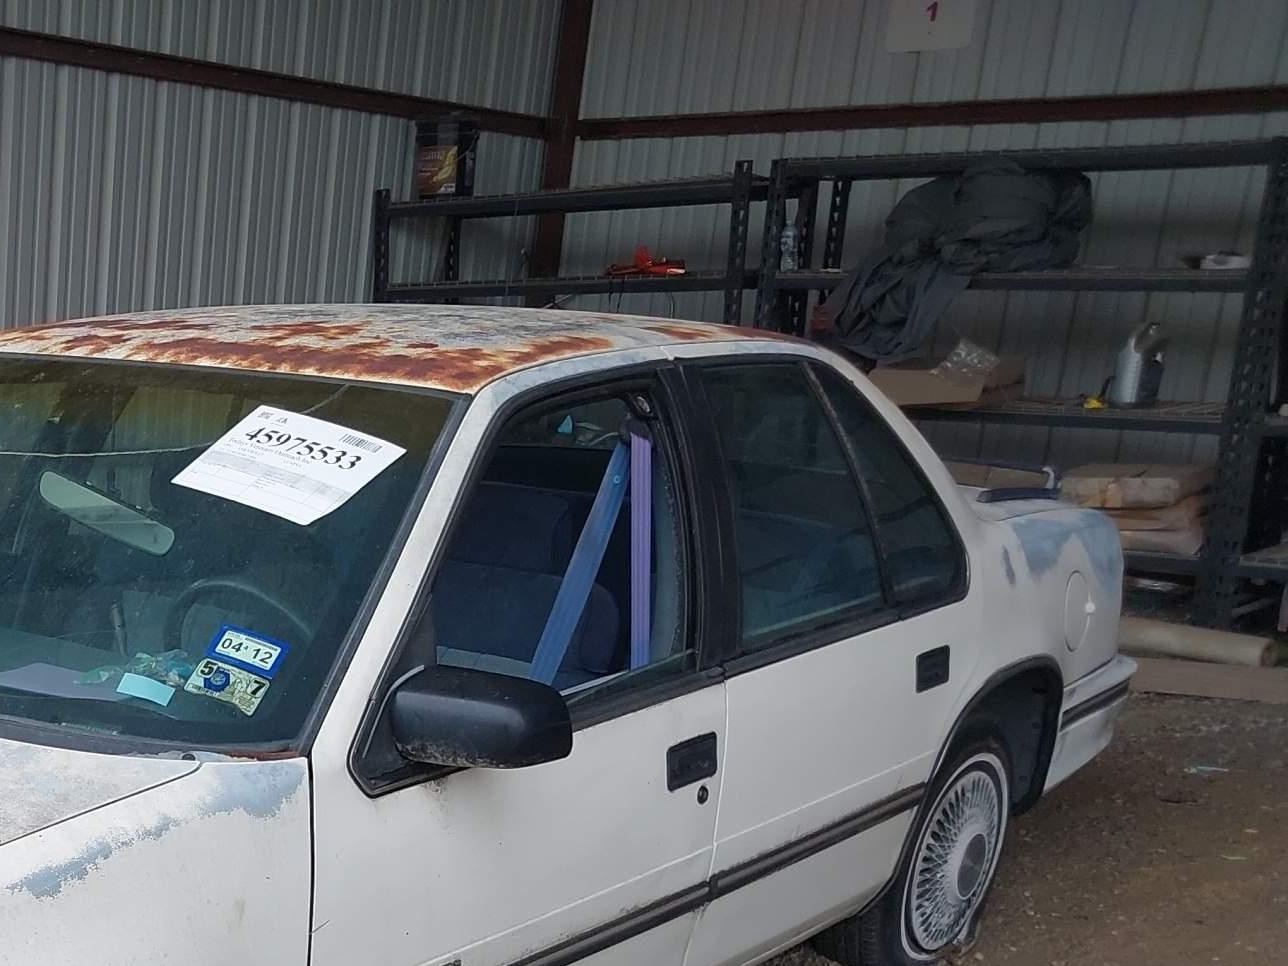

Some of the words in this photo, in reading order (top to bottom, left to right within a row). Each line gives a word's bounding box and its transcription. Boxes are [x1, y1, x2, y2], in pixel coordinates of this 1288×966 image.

[927, 2, 938, 21] 1
[246, 427, 362, 469] 45975533
[221, 637, 244, 653] 04
[252, 648, 273, 664] 12
[200, 661, 218, 675] 5
[251, 680, 266, 695] 7
